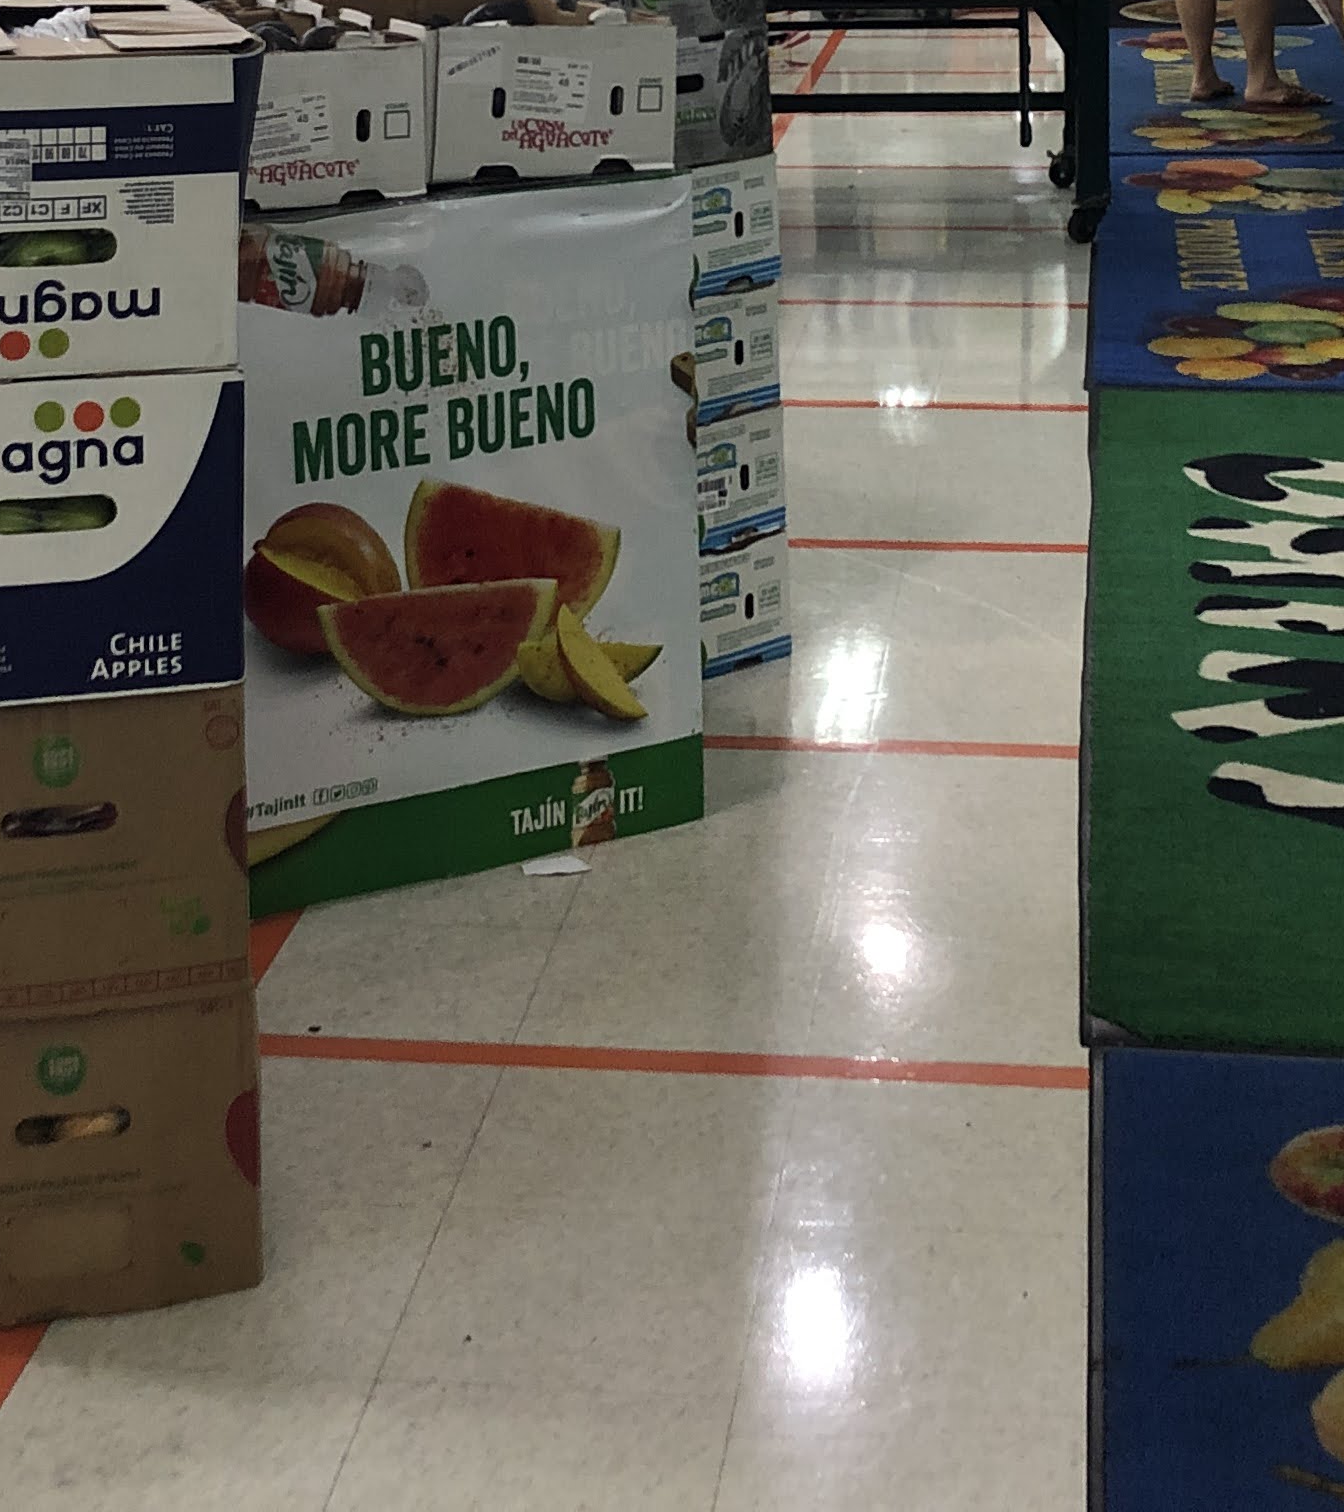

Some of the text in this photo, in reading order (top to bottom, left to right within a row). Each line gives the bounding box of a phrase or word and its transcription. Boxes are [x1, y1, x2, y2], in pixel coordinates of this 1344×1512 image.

[2, 205, 23, 217] C2
[30, 204, 51, 216] C1
[63, 201, 71, 214] F
[81, 200, 102, 213] XF
[360, 316, 529, 397] BUENO,
[293, 377, 596, 485] MORE BUENO
[110, 632, 183, 656] CHILE
[91, 656, 183, 680] APPLES
[511, 796, 566, 836] TAJÍN
[619, 786, 644, 814] IT!
